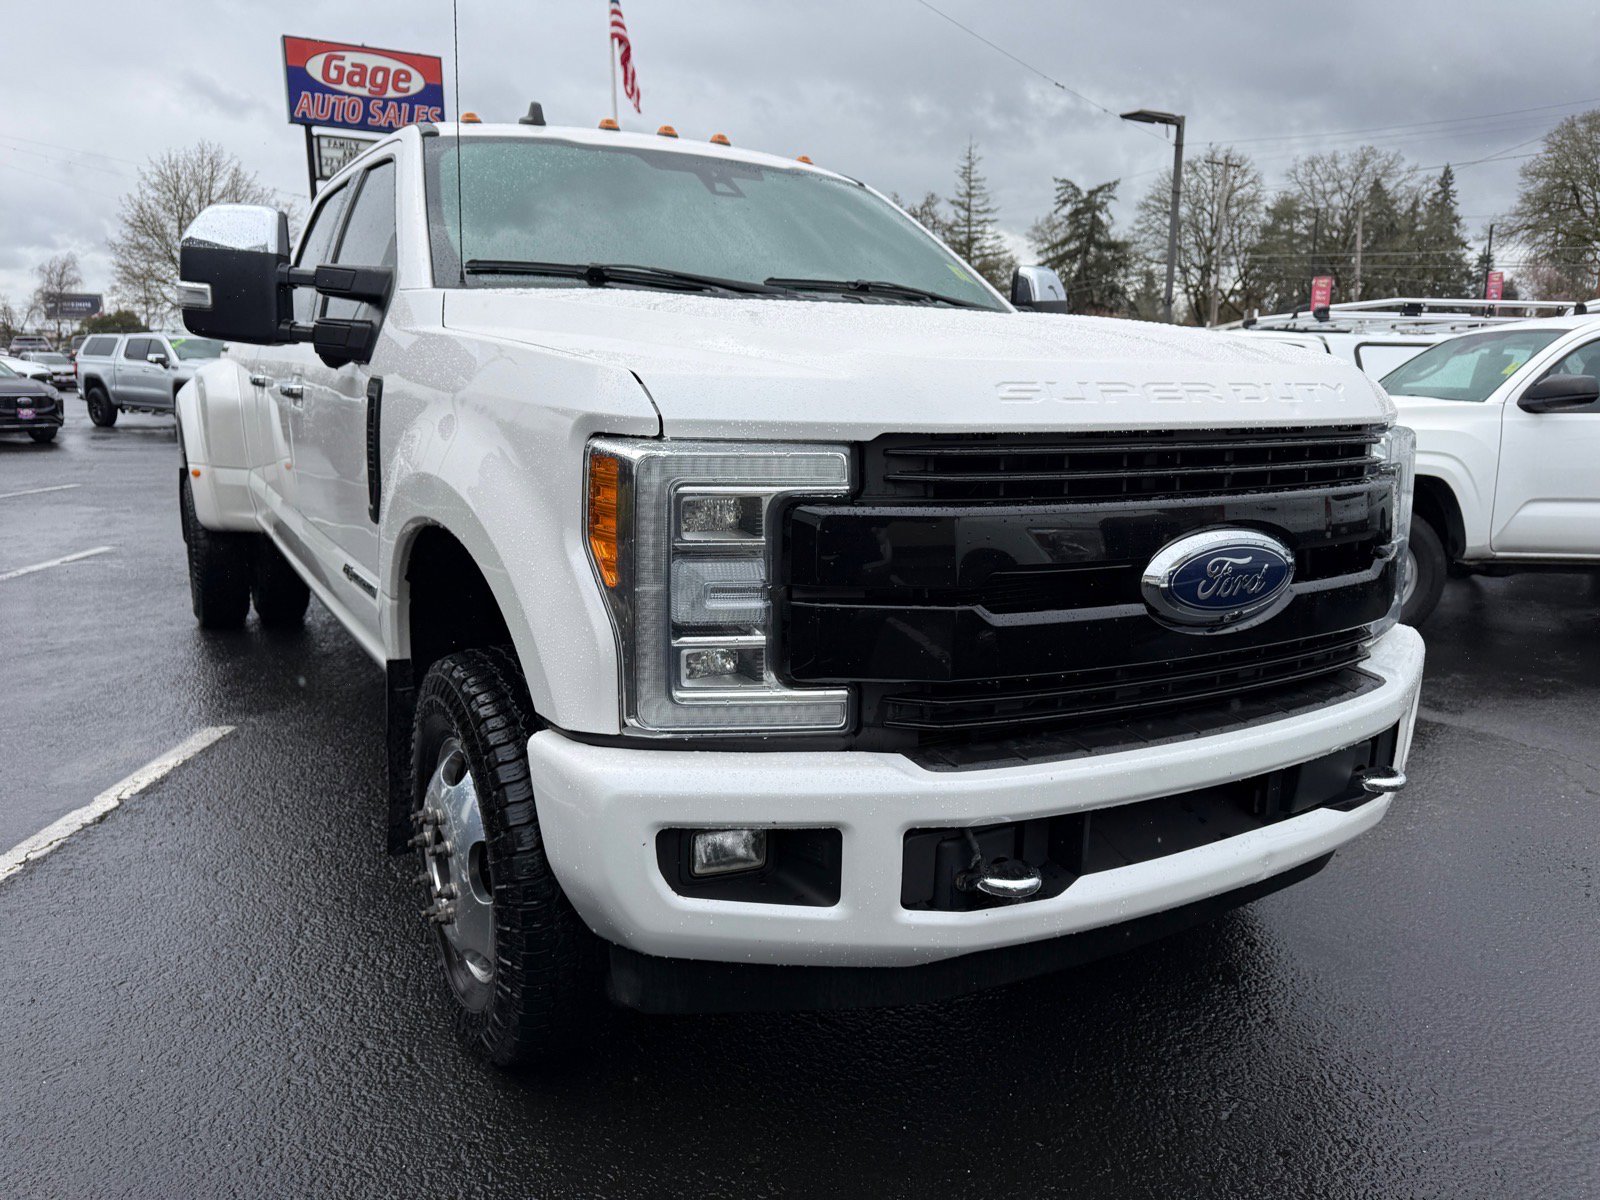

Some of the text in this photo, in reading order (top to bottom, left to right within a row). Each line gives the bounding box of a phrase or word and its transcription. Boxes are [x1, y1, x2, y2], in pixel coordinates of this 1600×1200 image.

[321, 53, 412, 97] Gage
[294, 91, 442, 127] AUTO SALES
[327, 138, 361, 150] FAMILY
[995, 381, 1347, 403] SUPER DUTY
[1197, 556, 1270, 600] Ford
